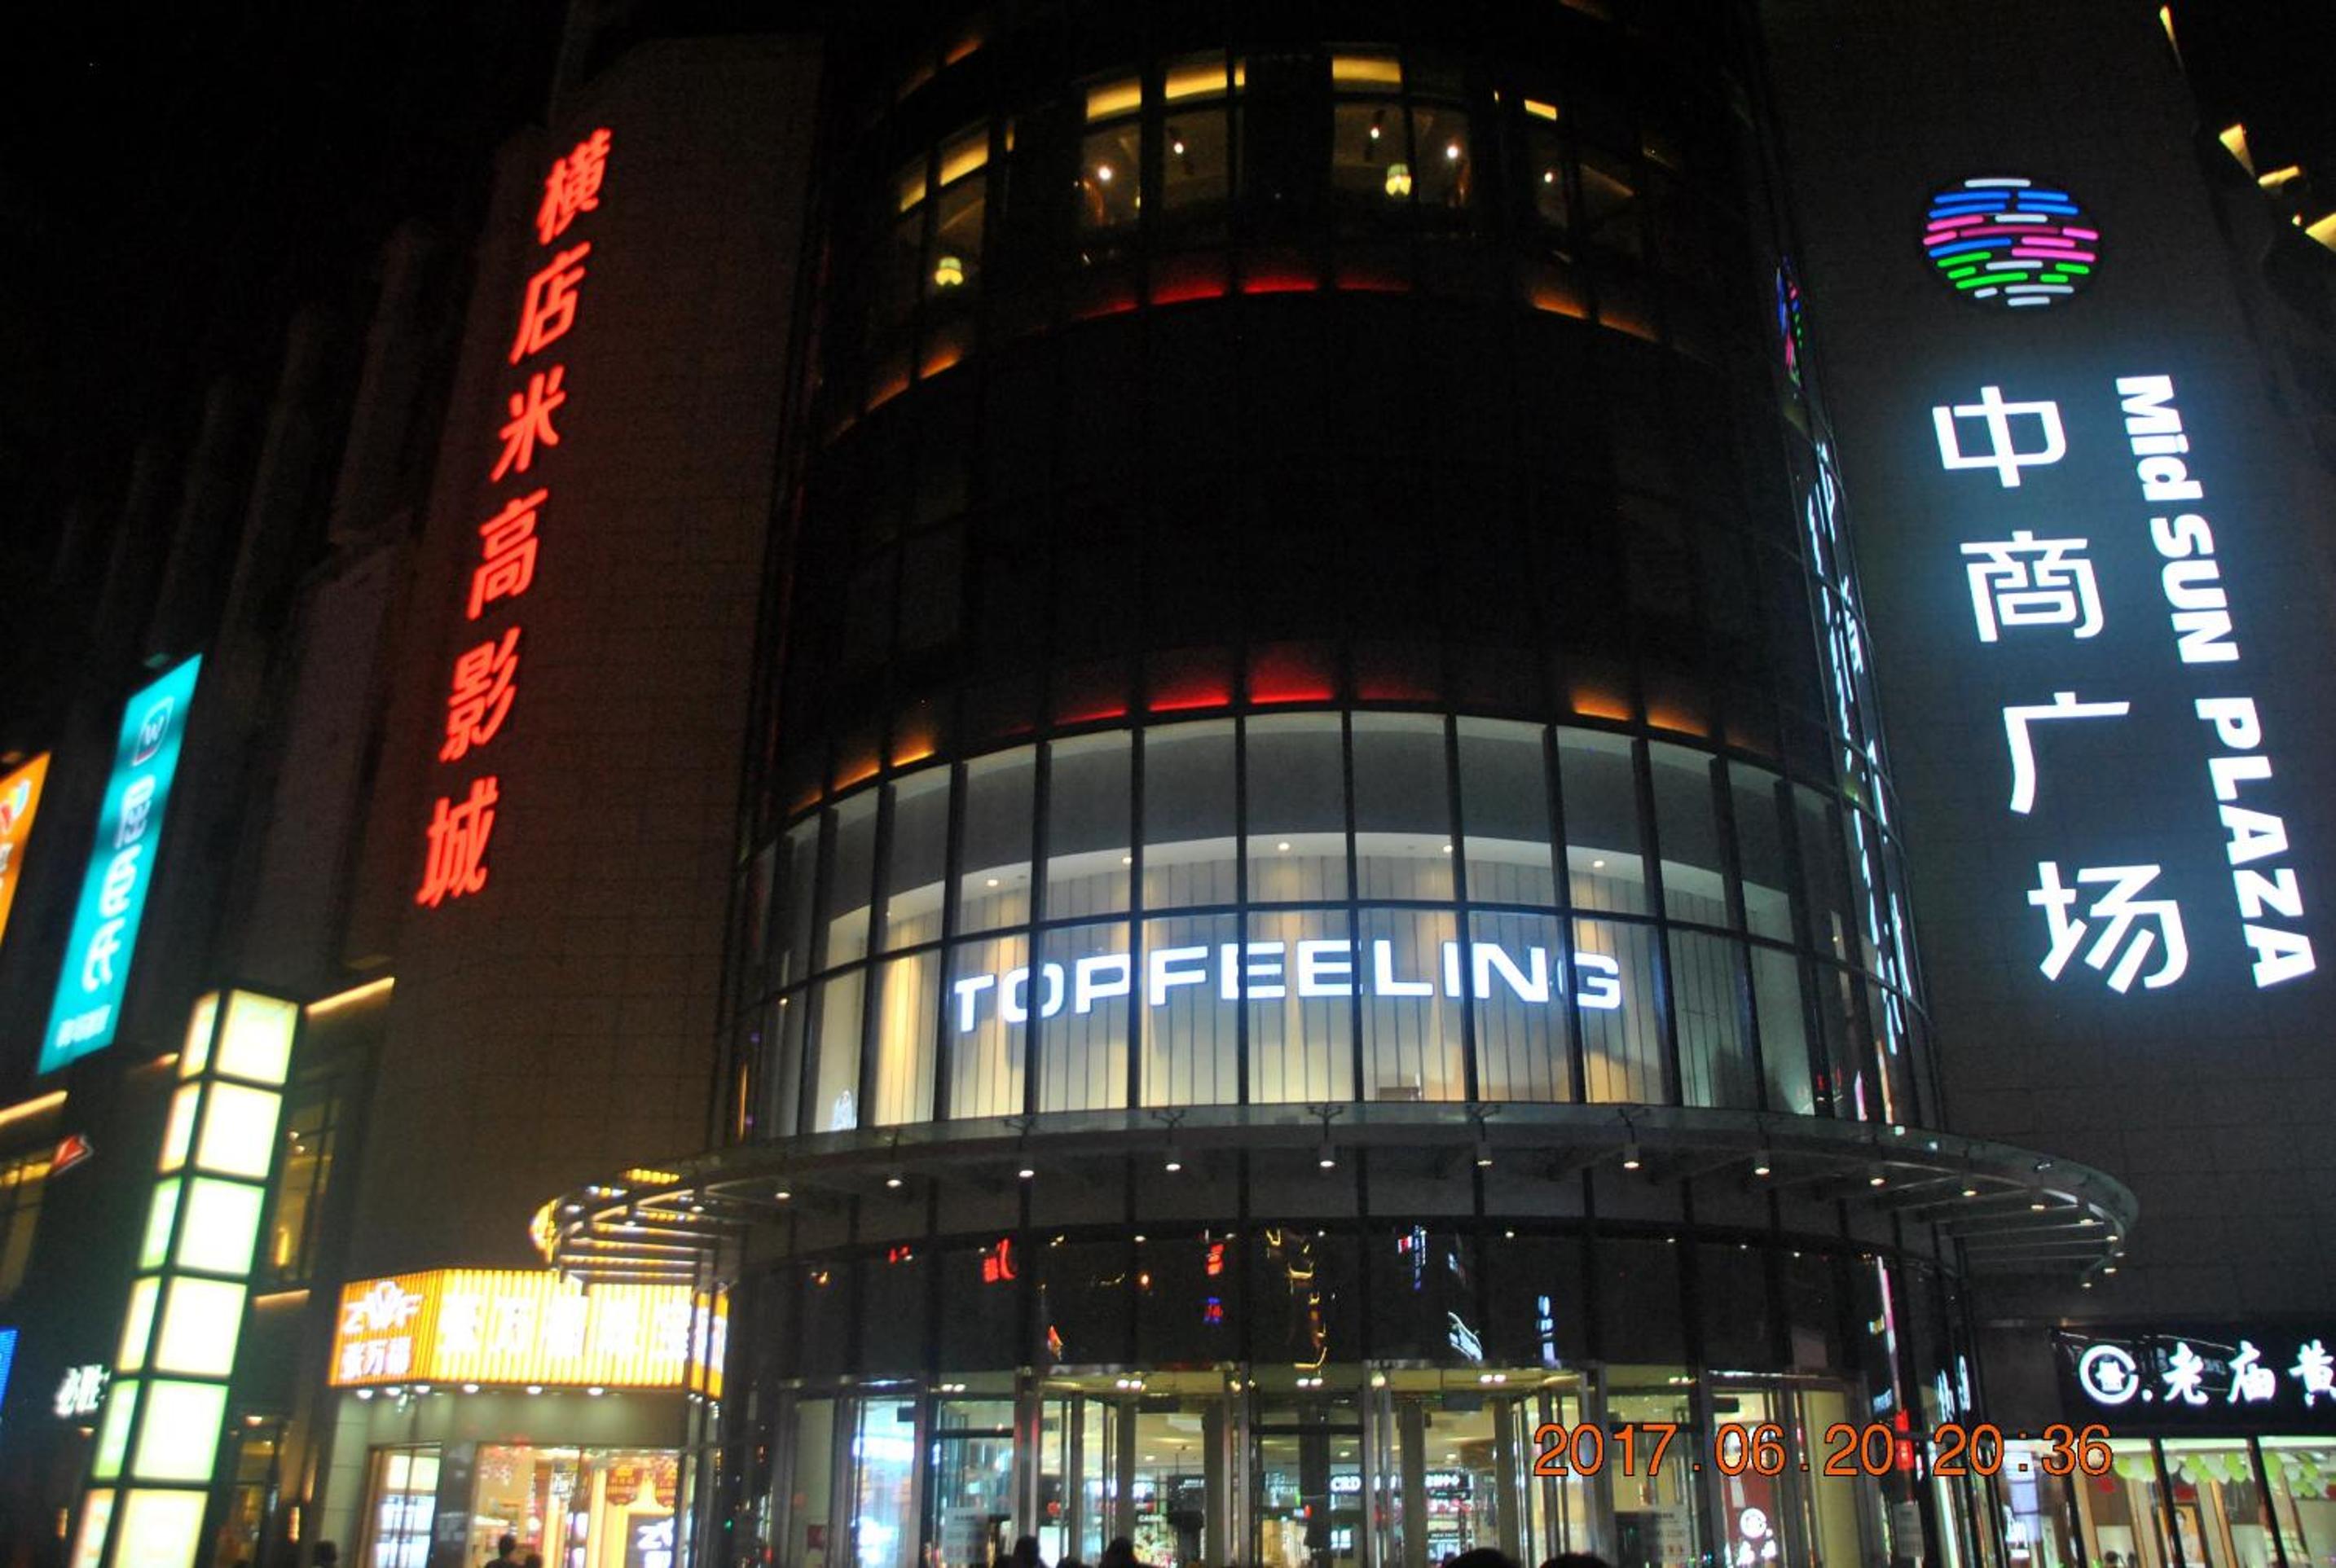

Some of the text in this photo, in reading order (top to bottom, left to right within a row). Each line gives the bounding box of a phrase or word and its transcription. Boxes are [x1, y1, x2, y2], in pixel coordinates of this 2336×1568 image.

[416, 128, 612, 908] 横店米高影城
[1931, 385, 2189, 995] 中商广场
[954, 938, 1622, 1032] TOPFEELING
[2195, 696, 2317, 988] PLAZA
